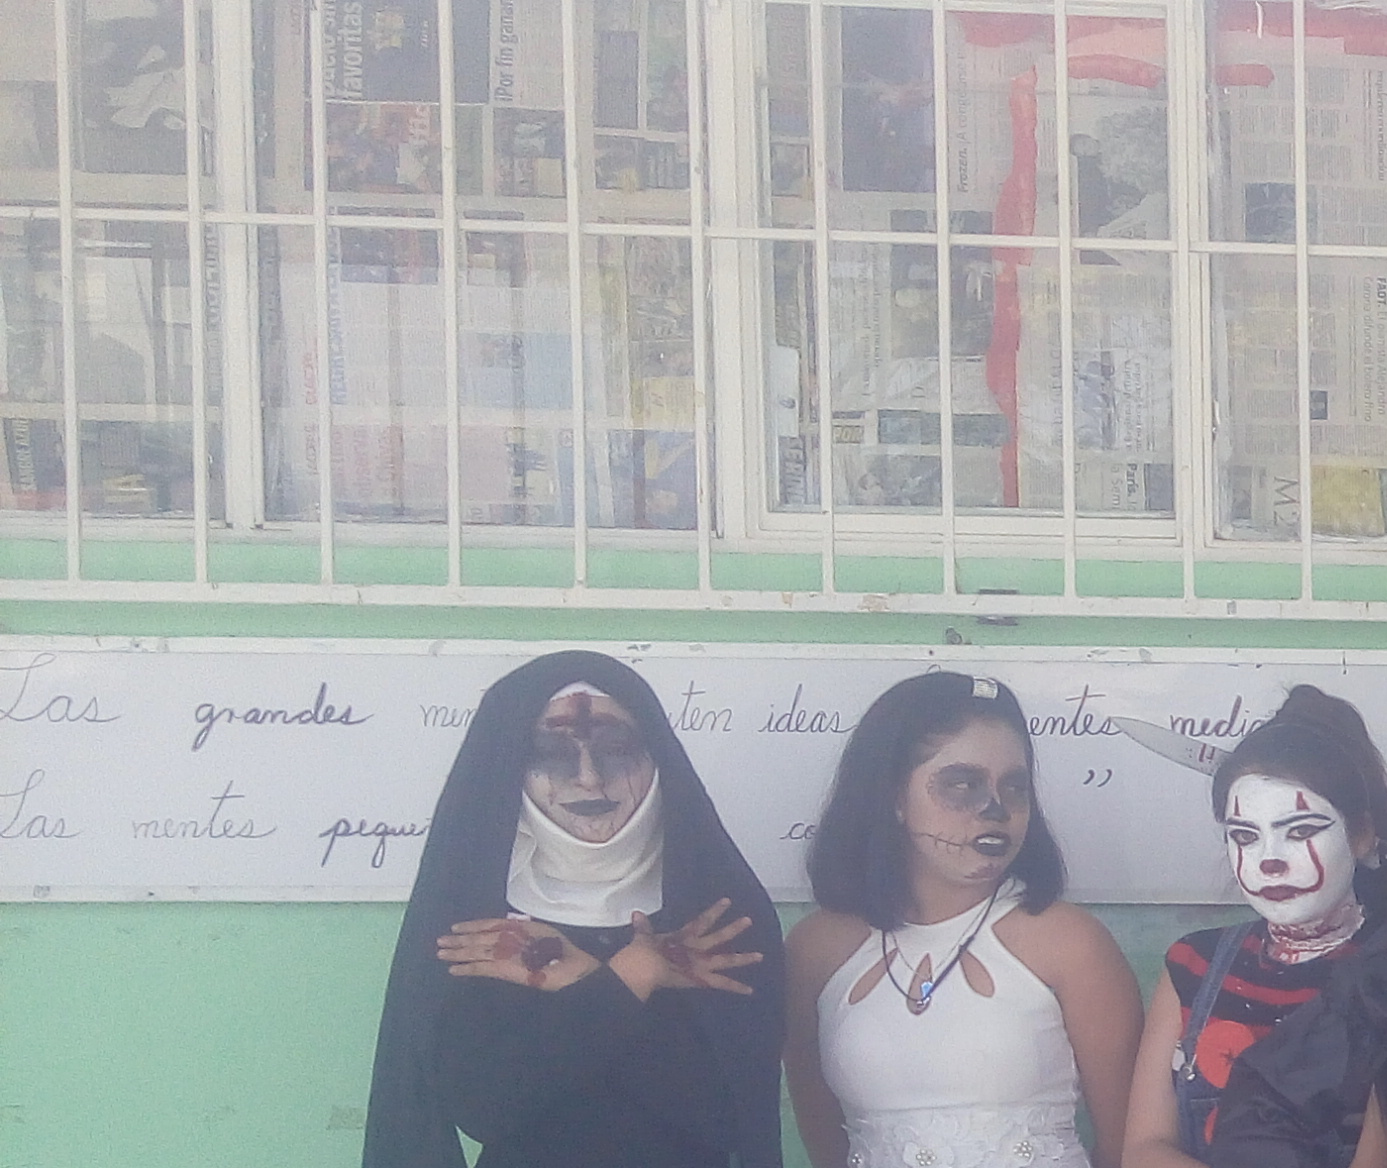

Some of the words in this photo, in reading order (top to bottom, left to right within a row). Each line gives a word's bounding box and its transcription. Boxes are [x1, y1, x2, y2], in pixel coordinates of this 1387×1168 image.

[337, 1, 363, 98] favoritas
[957, 148, 968, 193] Frozen.
[0, 652, 121, 723] Las
[191, 682, 375, 752] grandes
[757, 683, 858, 735] ideas
[1028, 682, 1123, 737] entes
[0, 768, 81, 840] Las
[132, 779, 277, 841] mentes
